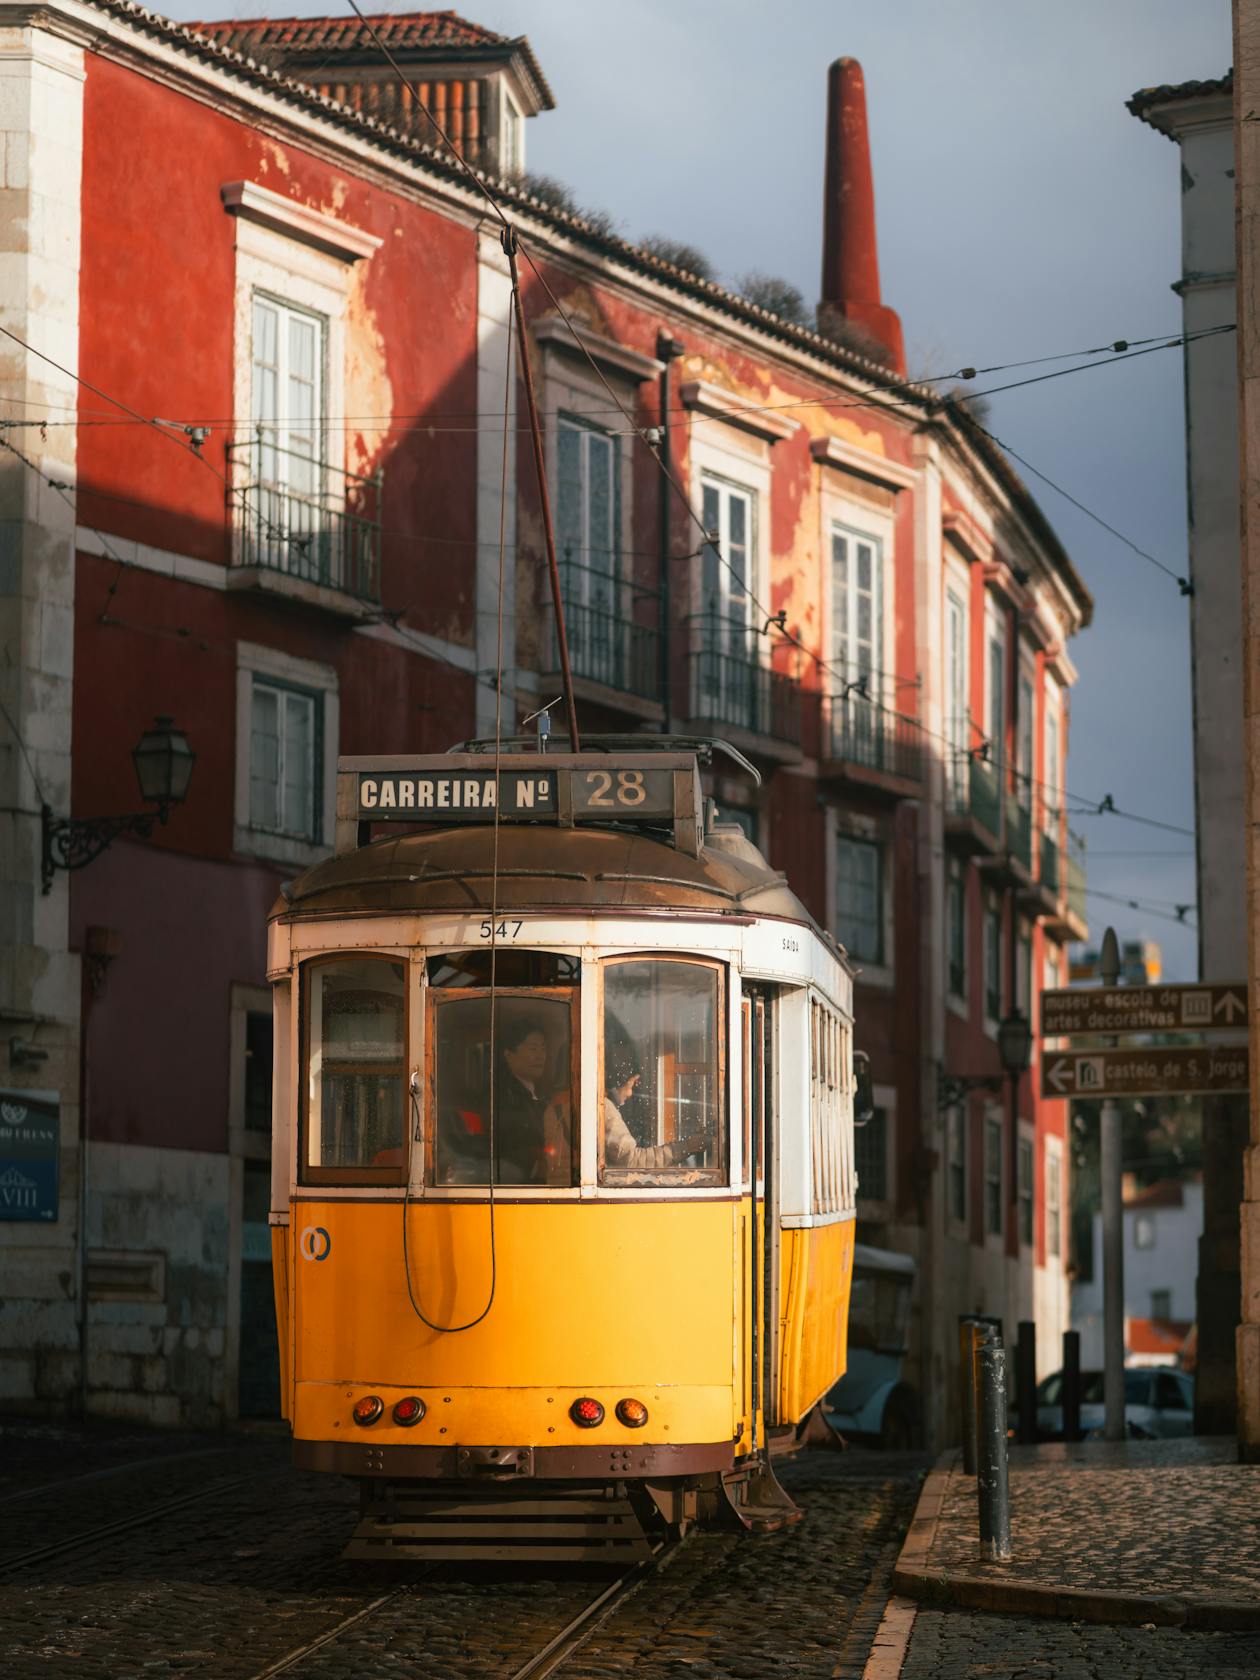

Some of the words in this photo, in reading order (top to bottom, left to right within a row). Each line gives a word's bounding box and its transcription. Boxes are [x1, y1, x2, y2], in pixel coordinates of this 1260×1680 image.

[361, 780, 498, 808] CARREIRA
[516, 779, 550, 808] Nº
[585, 770, 647, 806] 28
[480, 920, 524, 938] 547
[1045, 995, 1090, 1009] museu
[1104, 990, 1153, 1008] escola
[1159, 990, 1179, 1006] de
[1045, 1012, 1081, 1029] artes
[1087, 1009, 1175, 1028] decorativas
[1106, 1060, 1157, 1078] castelo
[1163, 1061, 1180, 1076] de
